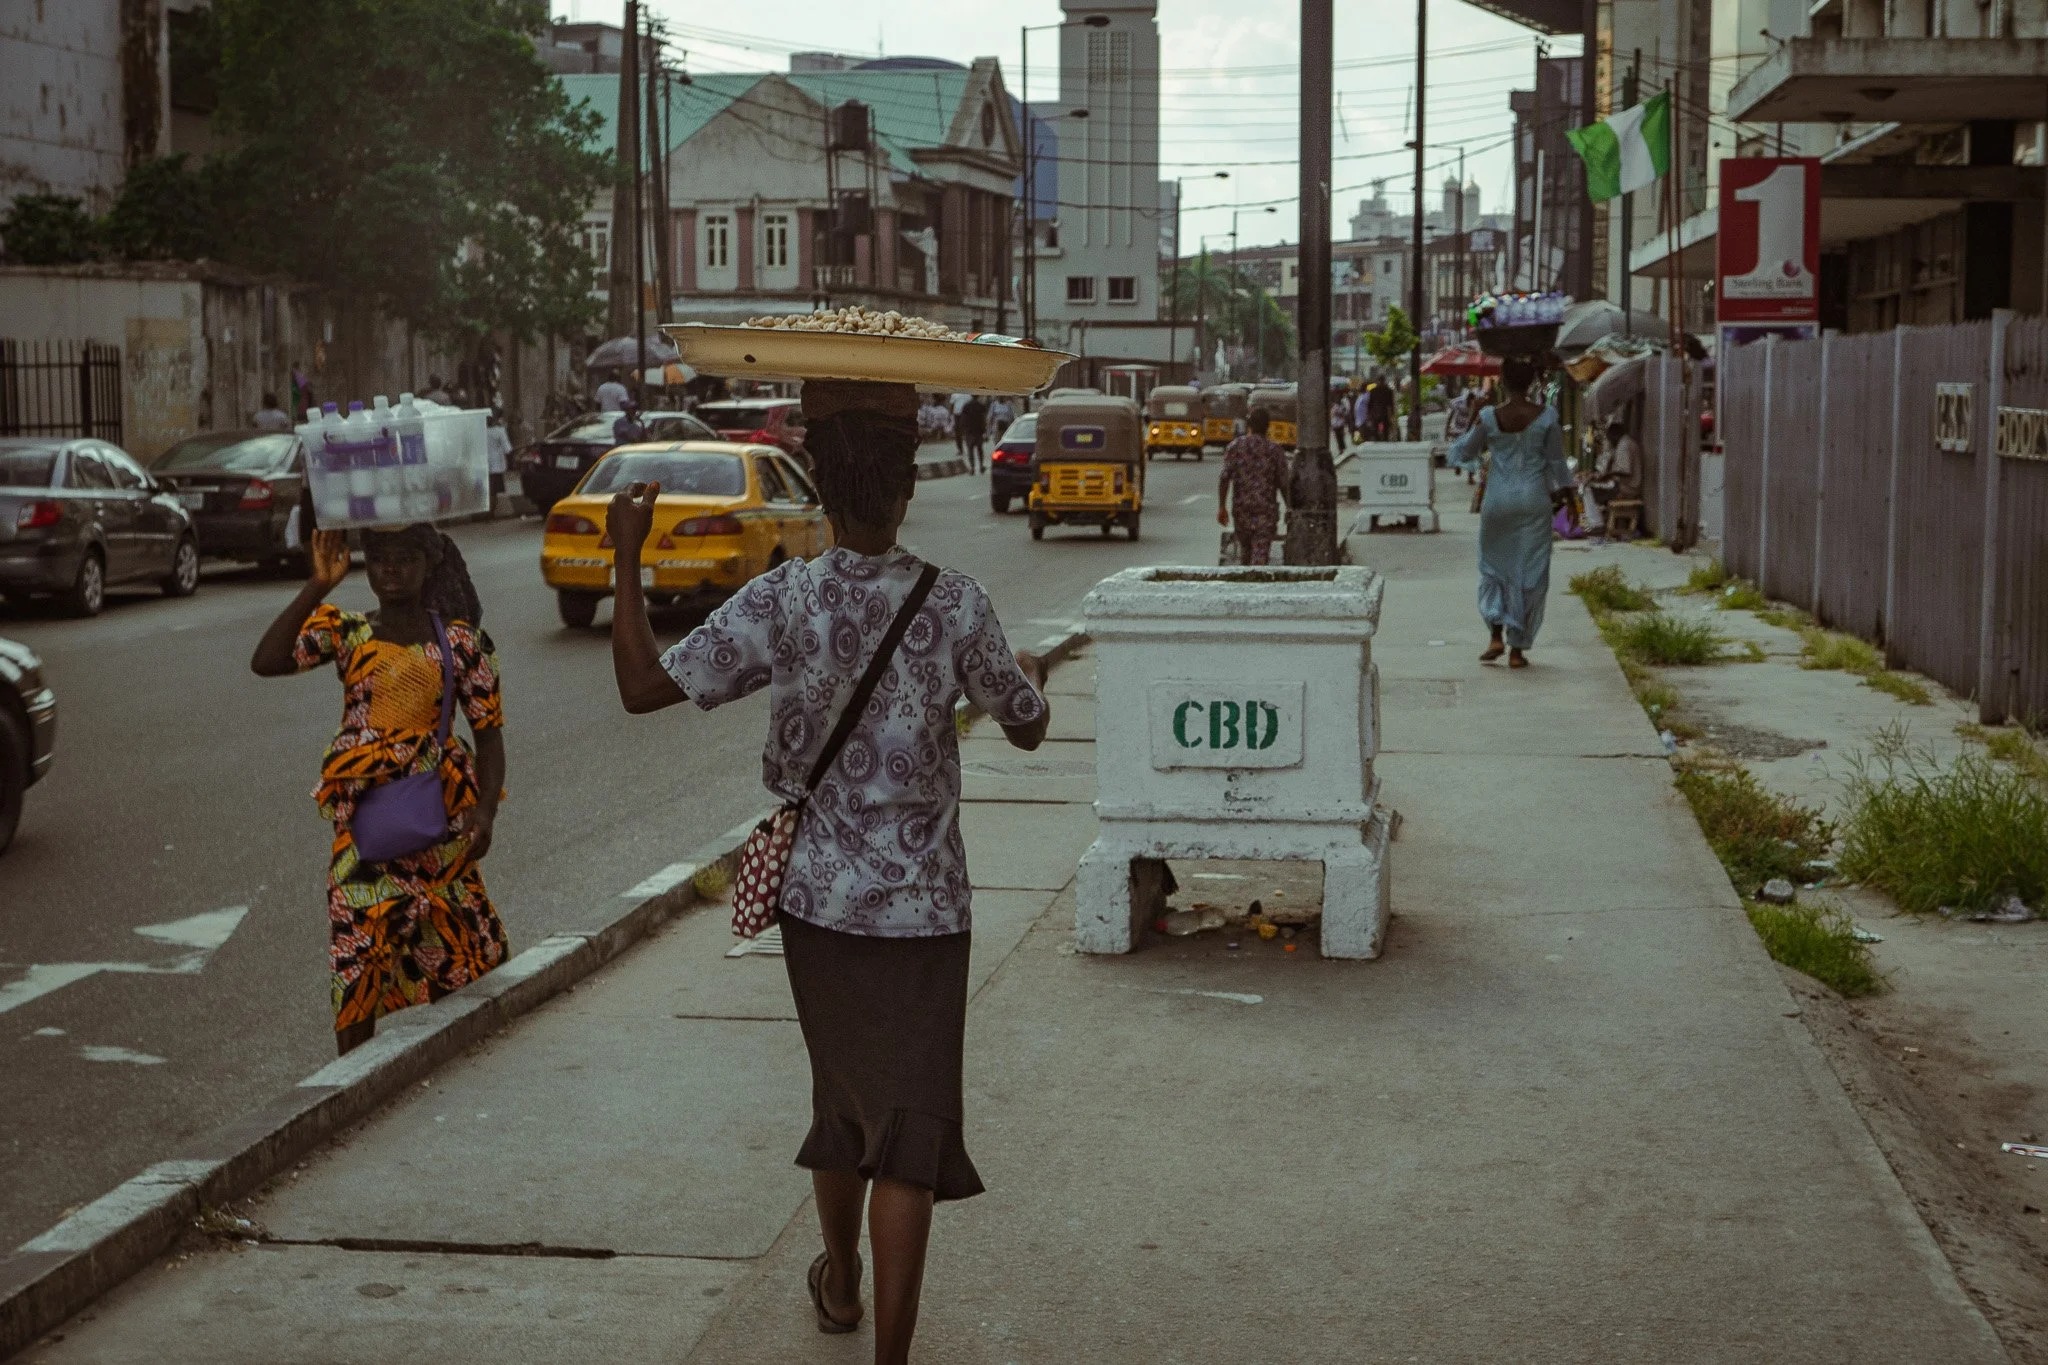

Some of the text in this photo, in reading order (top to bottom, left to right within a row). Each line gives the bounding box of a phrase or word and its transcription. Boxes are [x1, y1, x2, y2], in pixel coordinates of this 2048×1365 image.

[1723, 164, 1815, 298] 1
[1380, 473, 1409, 487] CBD
[1172, 700, 1279, 750] CBD
